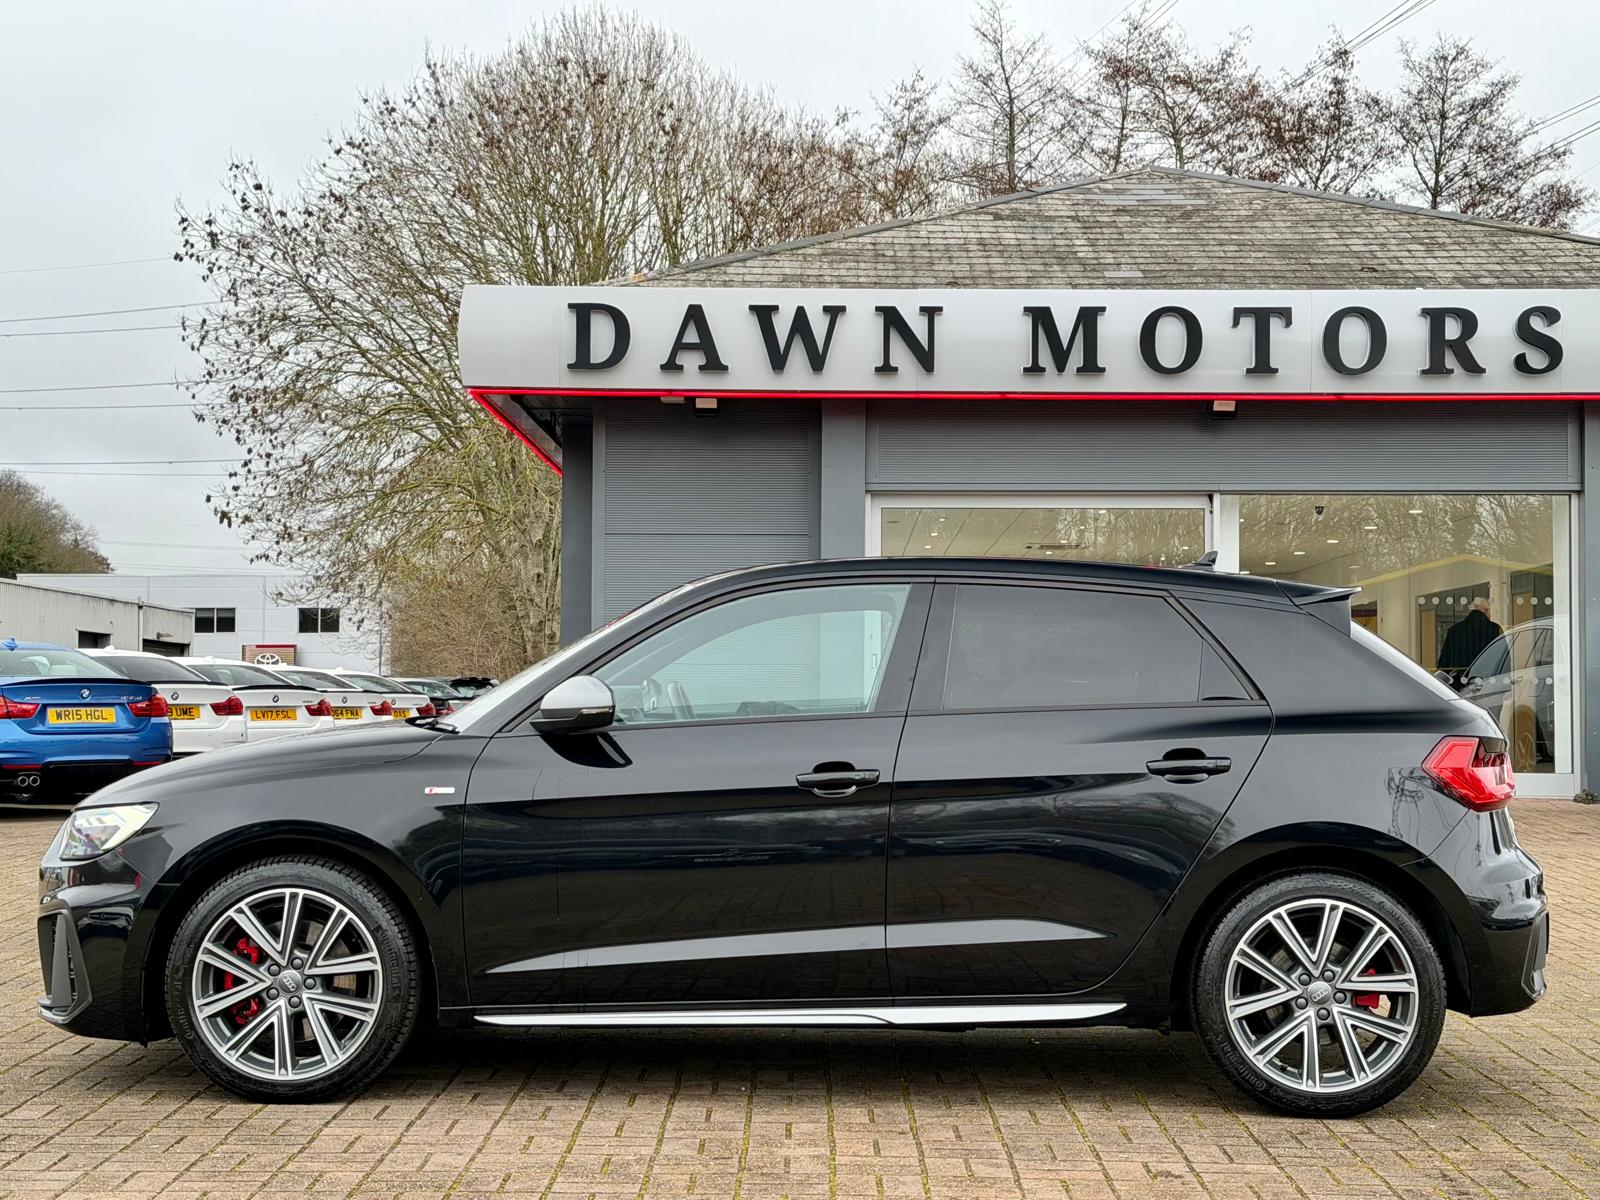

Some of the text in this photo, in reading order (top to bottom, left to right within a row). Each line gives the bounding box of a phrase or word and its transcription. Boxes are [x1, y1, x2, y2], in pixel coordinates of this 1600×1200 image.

[567, 302, 1564, 375] DAWN MOTORS
[56, 709, 108, 721] WR15 HGL
[175, 707, 195, 717] UME
[255, 710, 292, 719] LV17 FSL
[1220, 1041, 1267, 1091] Continental
